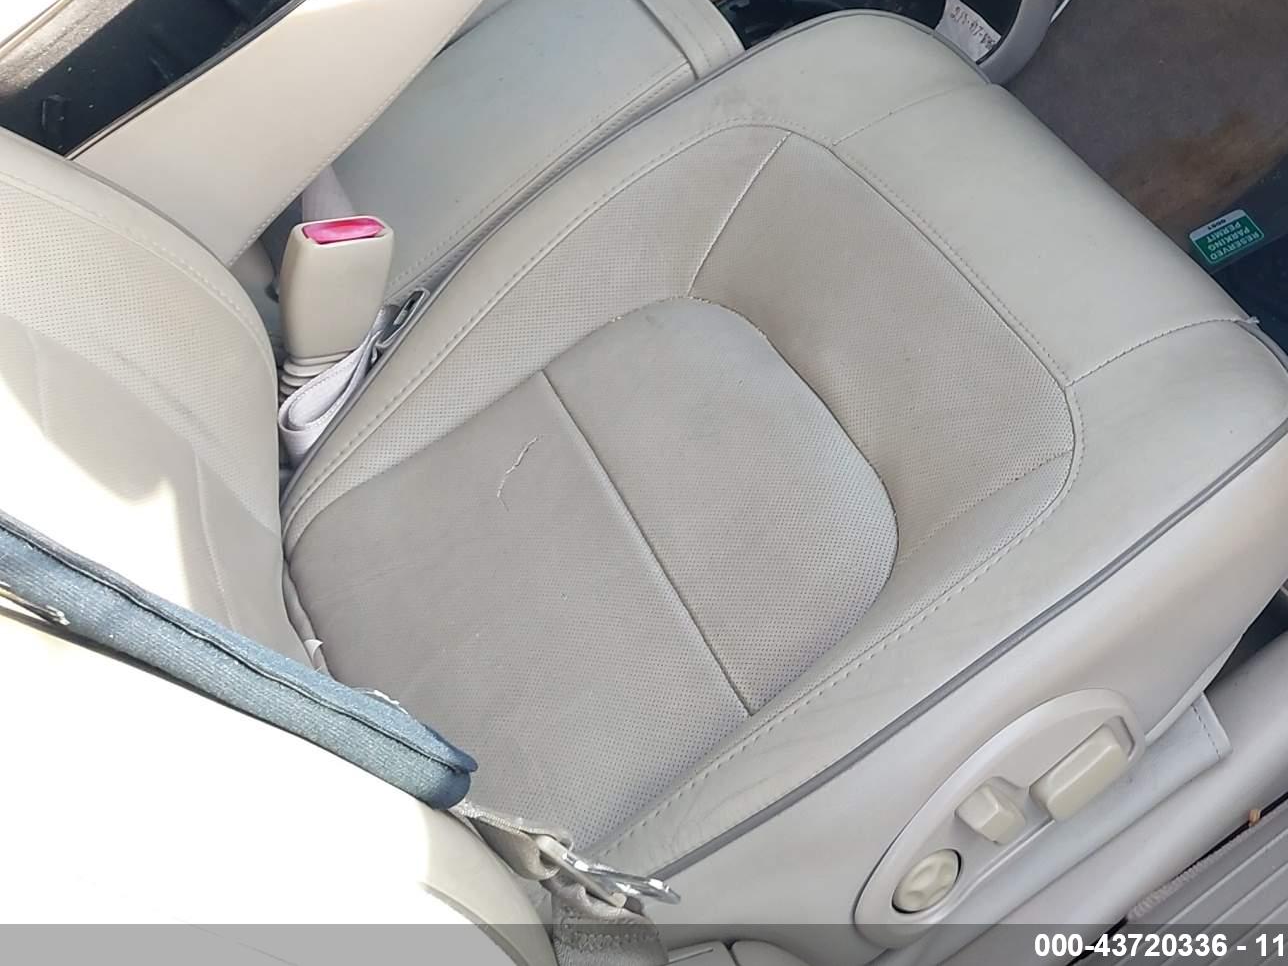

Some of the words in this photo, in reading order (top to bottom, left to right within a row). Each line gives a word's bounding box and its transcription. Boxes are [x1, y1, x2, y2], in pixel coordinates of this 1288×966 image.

[1206, 221, 1241, 243] PERMIT
[1207, 226, 1251, 251] PARKING
[1209, 231, 1260, 260] RESERVED
